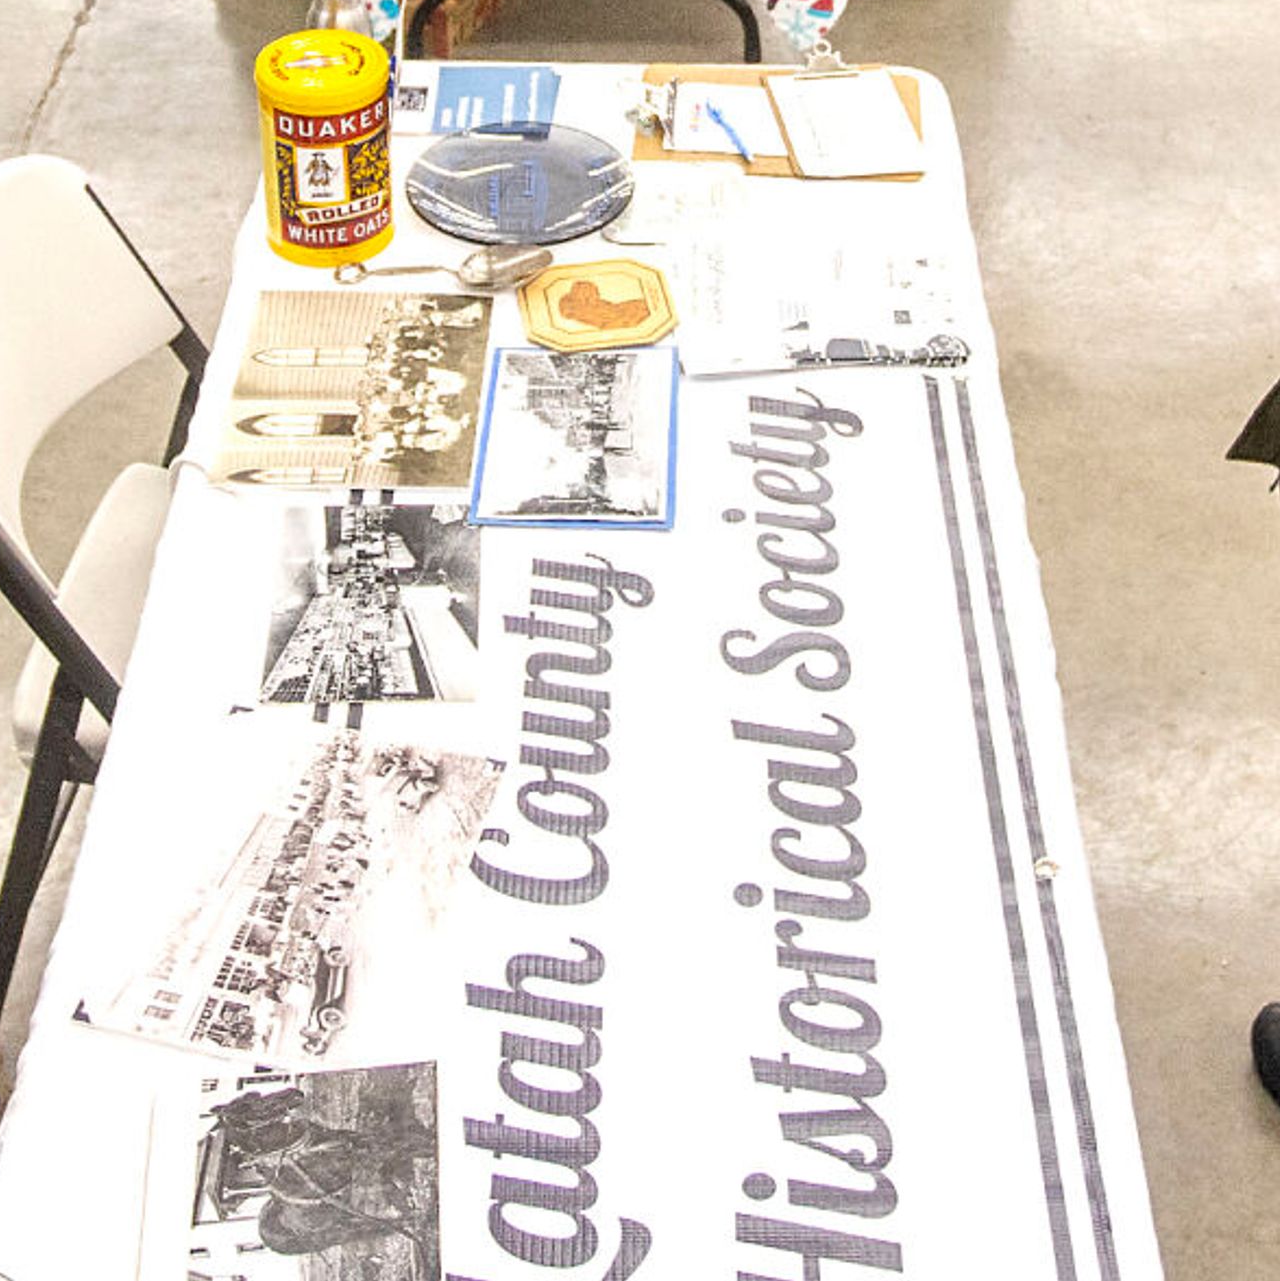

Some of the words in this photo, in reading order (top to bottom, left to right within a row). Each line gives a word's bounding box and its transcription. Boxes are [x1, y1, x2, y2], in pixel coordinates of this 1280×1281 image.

[278, 100, 385, 138] QUAKER
[287, 222, 349, 244] WHITE
[353, 207, 390, 237] OATS
[306, 196, 380, 223] ROLLED
[720, 387, 863, 692] Society
[469, 552, 655, 906] County
[731, 713, 905, 1281] Historical
